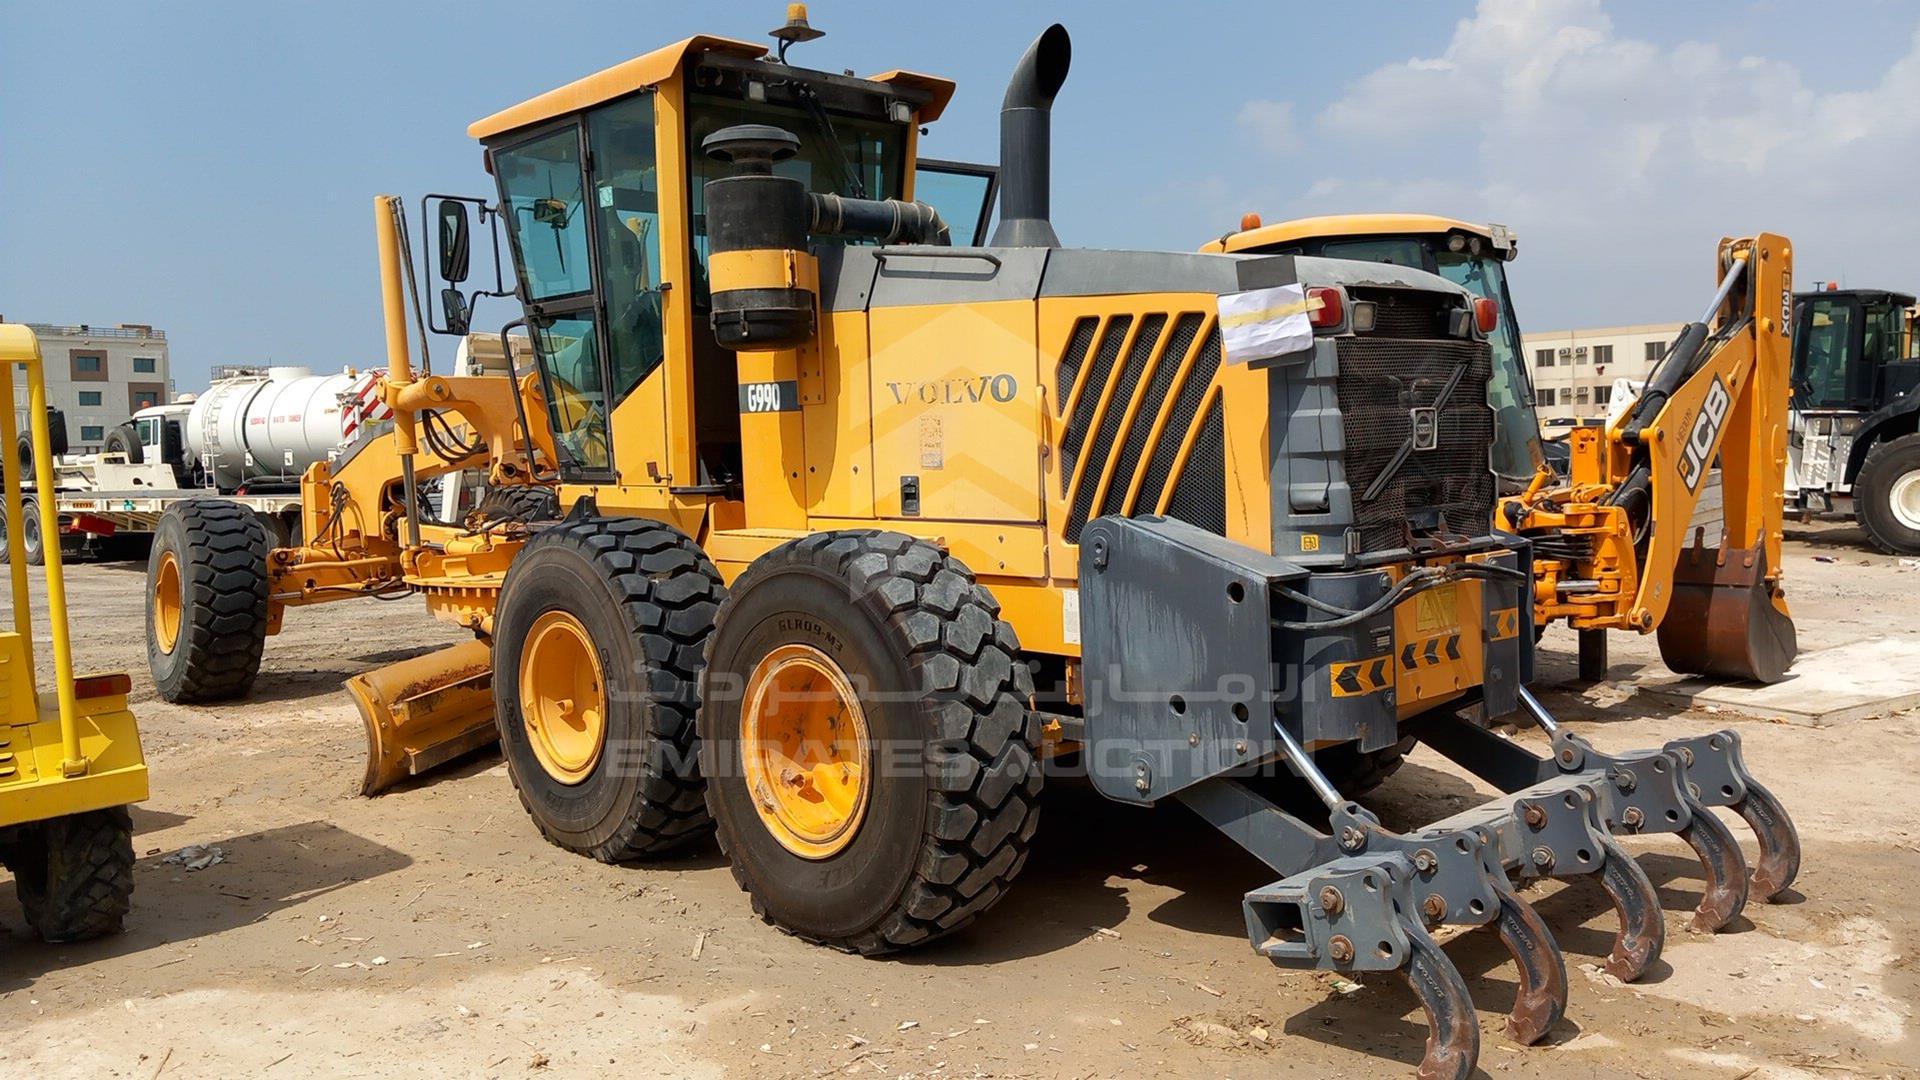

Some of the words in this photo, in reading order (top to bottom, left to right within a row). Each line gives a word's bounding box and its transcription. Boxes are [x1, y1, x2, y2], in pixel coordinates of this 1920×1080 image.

[1781, 291, 1790, 334] 3CX
[747, 383, 780, 412] G990
[886, 374, 1017, 404] VOLVO
[1685, 379, 1728, 489] JCB
